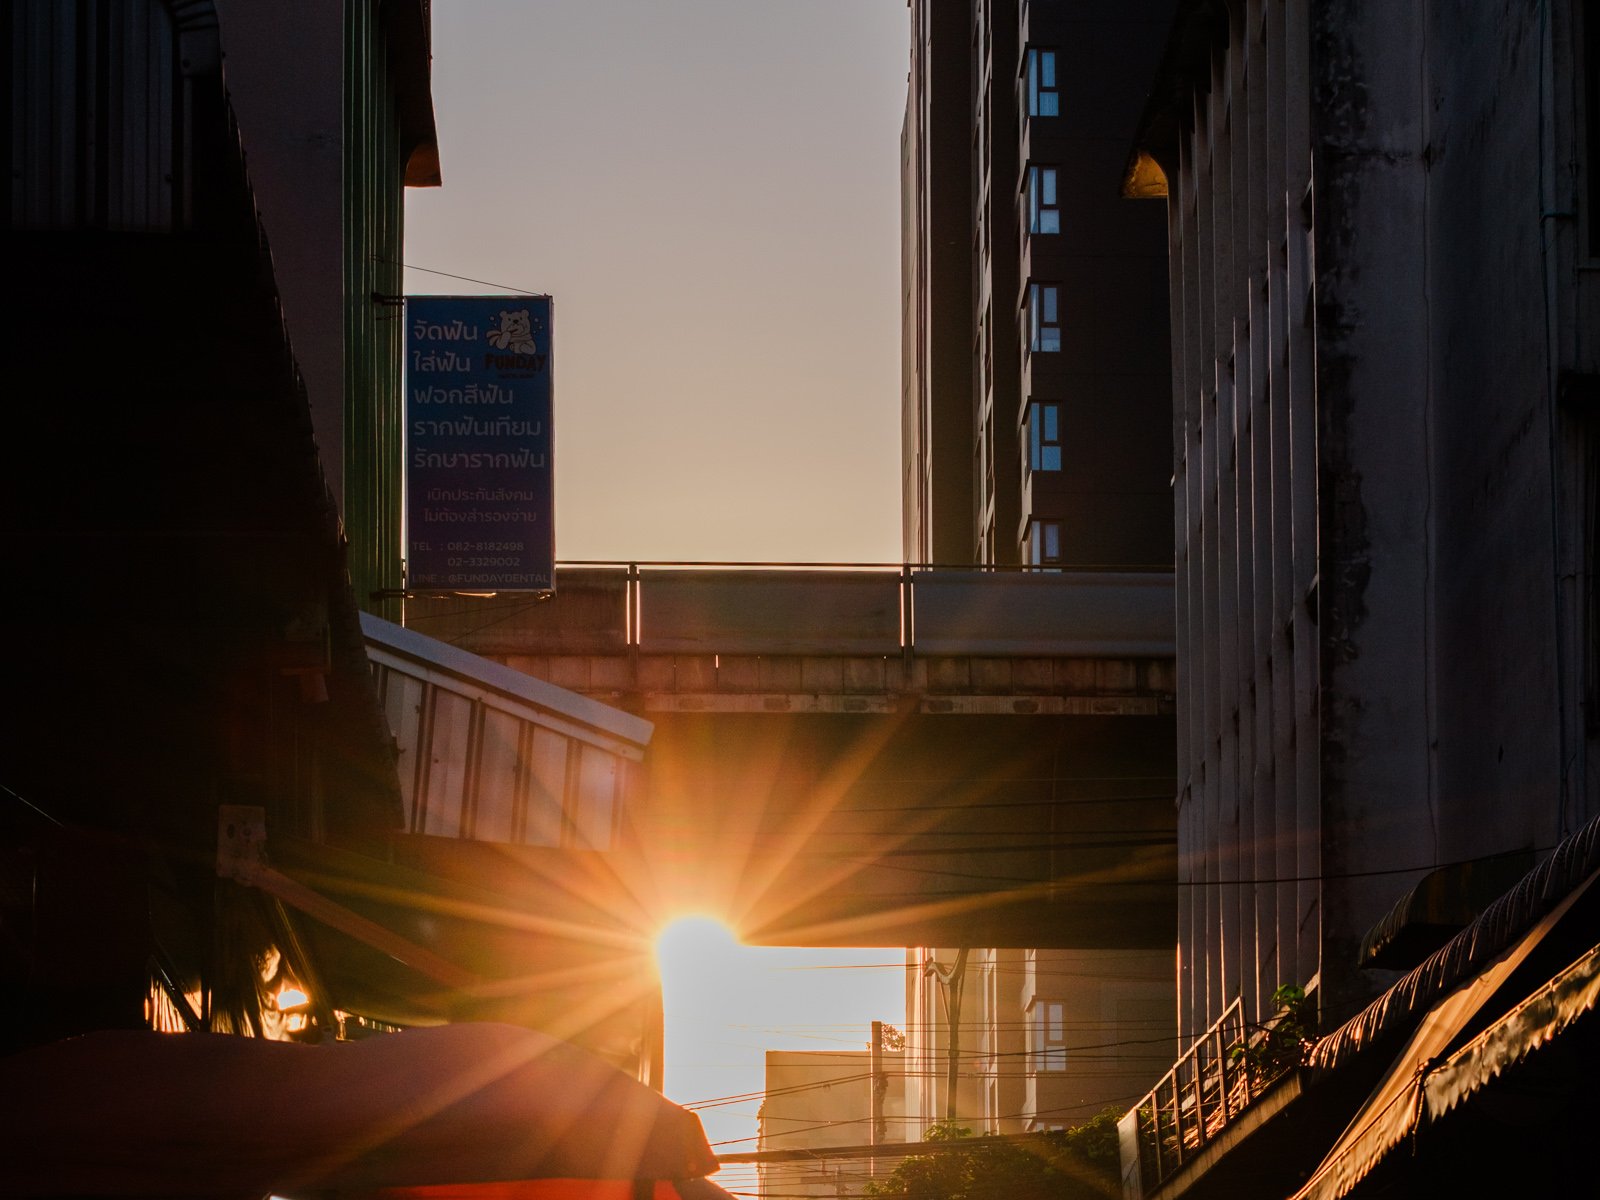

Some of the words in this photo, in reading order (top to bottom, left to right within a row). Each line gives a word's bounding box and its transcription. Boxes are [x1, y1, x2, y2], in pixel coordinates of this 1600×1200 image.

[413, 319, 478, 341] จัดฟัน
[412, 349, 471, 372] ใส่ฟัน
[485, 353, 547, 372] FUNDAY
[413, 384, 513, 405] ฟอกสีฟัน
[413, 415, 541, 436] รากฟันเทียม
[413, 447, 545, 468] รักษารากฟัน
[427, 487, 534, 501] เบิกประกันสังคม
[423, 507, 537, 522] ไม่ต้องสำรองจ่าย
[412, 542, 433, 551] TEL
[411, 574, 438, 583] LINE
[448, 573, 549, 583] @FUNDAYDENTAL
